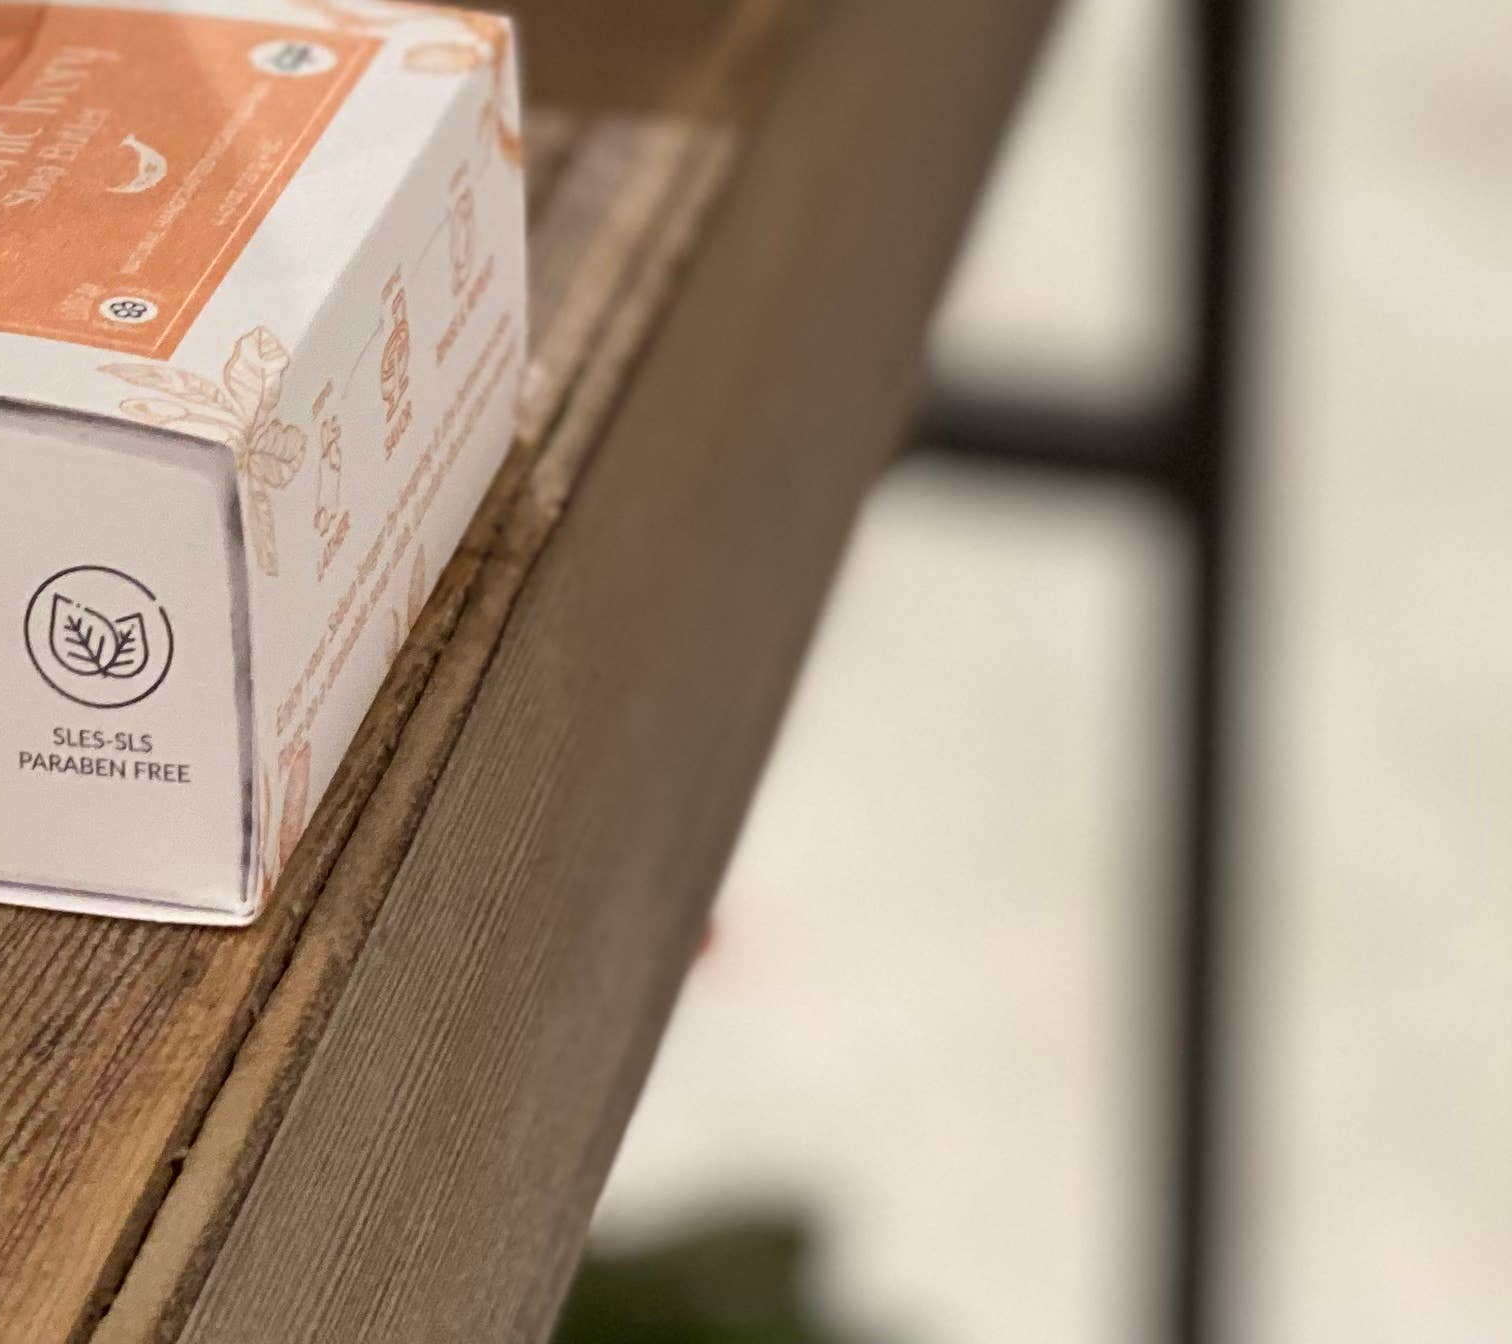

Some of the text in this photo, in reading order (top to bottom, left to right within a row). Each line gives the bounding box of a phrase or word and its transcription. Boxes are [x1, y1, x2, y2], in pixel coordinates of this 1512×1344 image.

[51, 726, 154, 755] SLES-SLS
[18, 750, 192, 784] PARABEN FREE
